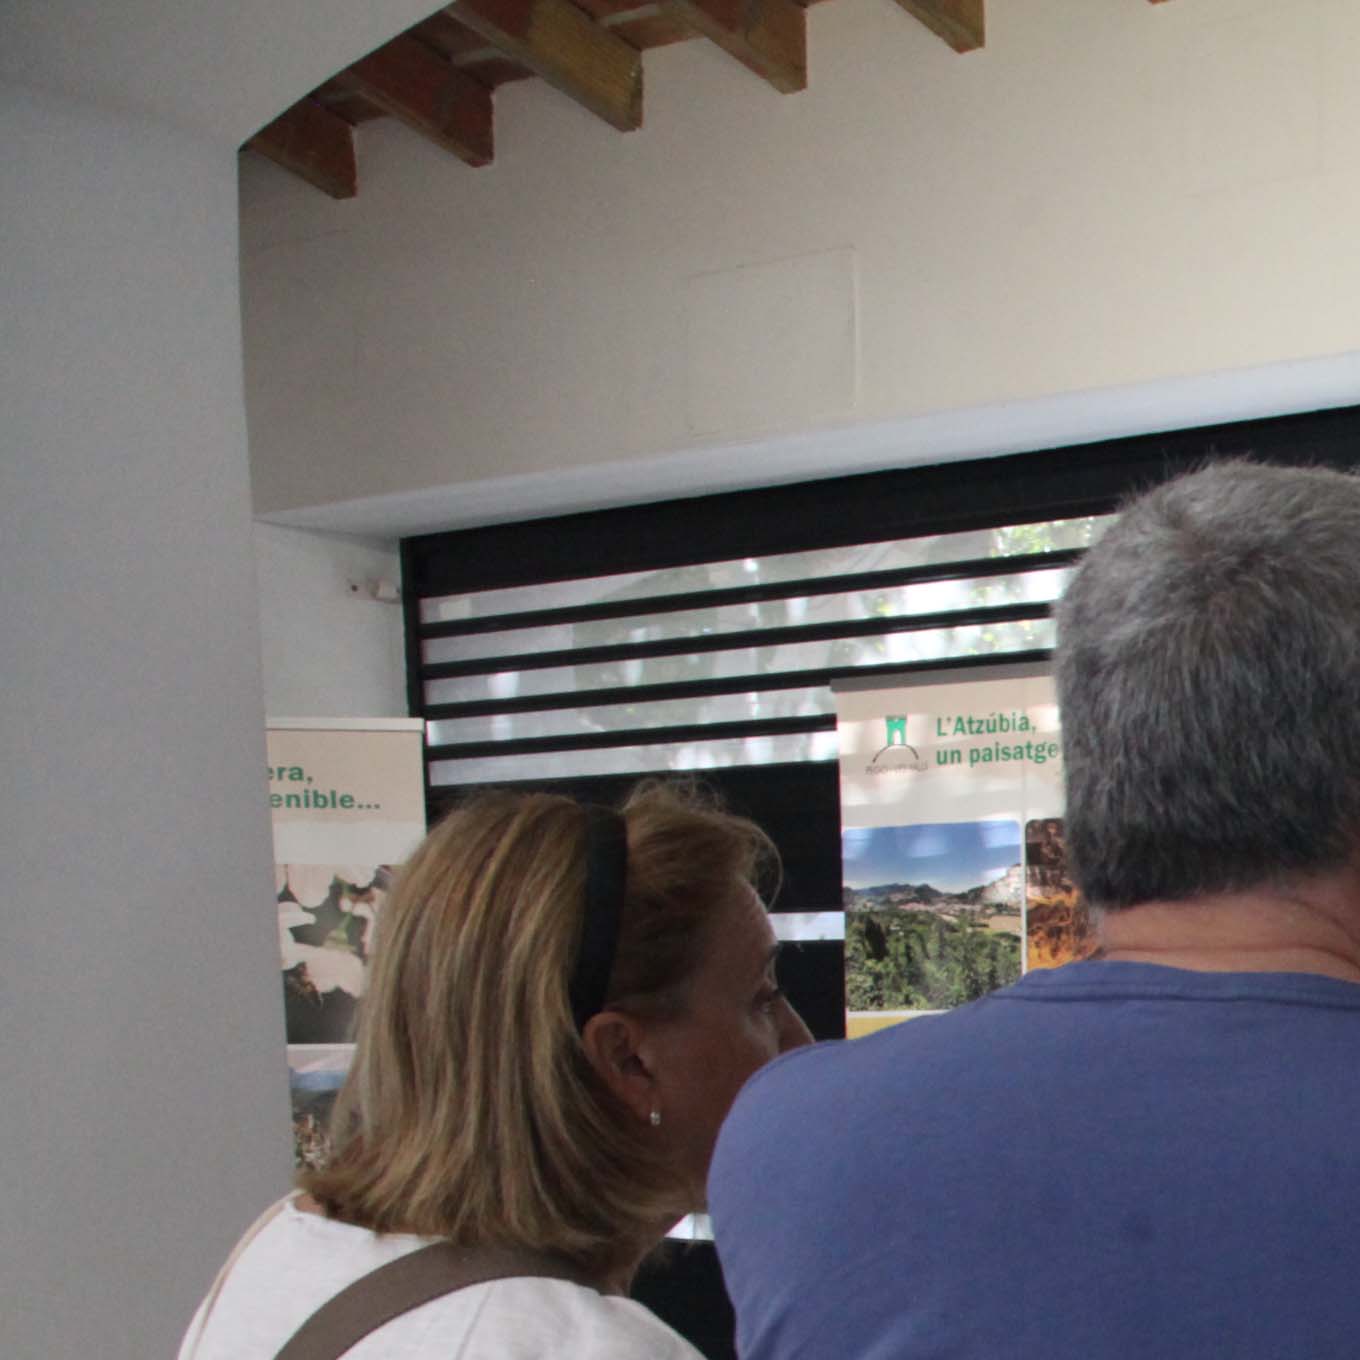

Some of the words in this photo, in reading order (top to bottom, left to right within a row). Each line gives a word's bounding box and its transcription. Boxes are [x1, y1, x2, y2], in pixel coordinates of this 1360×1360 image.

[936, 710, 1038, 738] L'Atzúbia,
[936, 748, 961, 766] un
[968, 741, 1058, 768] paisatge
